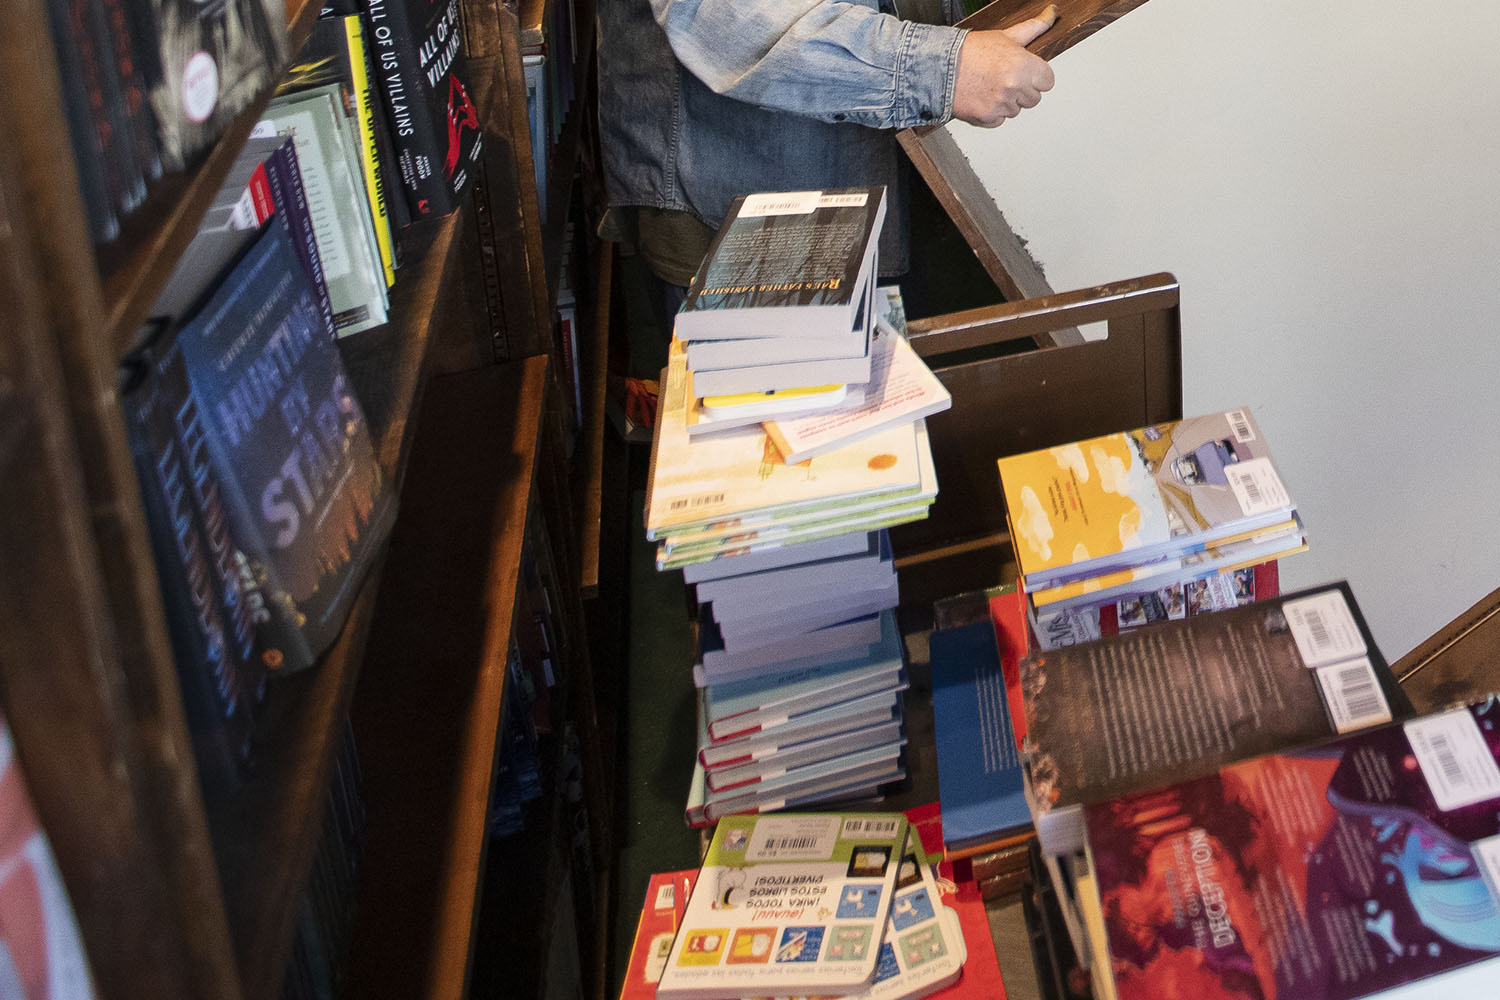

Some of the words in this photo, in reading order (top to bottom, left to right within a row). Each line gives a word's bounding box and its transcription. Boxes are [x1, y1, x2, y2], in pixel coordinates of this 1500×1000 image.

[372, 24, 394, 48] OF
[419, 34, 438, 69] ALL
[436, 15, 449, 43] OF
[379, 50, 400, 70] US
[426, 29, 460, 88] VILLAINS
[384, 72, 417, 137] VILLAINS
[304, 232, 323, 283] SOUND
[698, 283, 755, 297] VANISHED
[756, 280, 802, 294] FATHER
[749, 886, 787, 897] LIBROS
[790, 885, 827, 896] ESTOS
[1189, 827, 1237, 948] DECEPTION
[745, 898, 782, 909] TODOS
